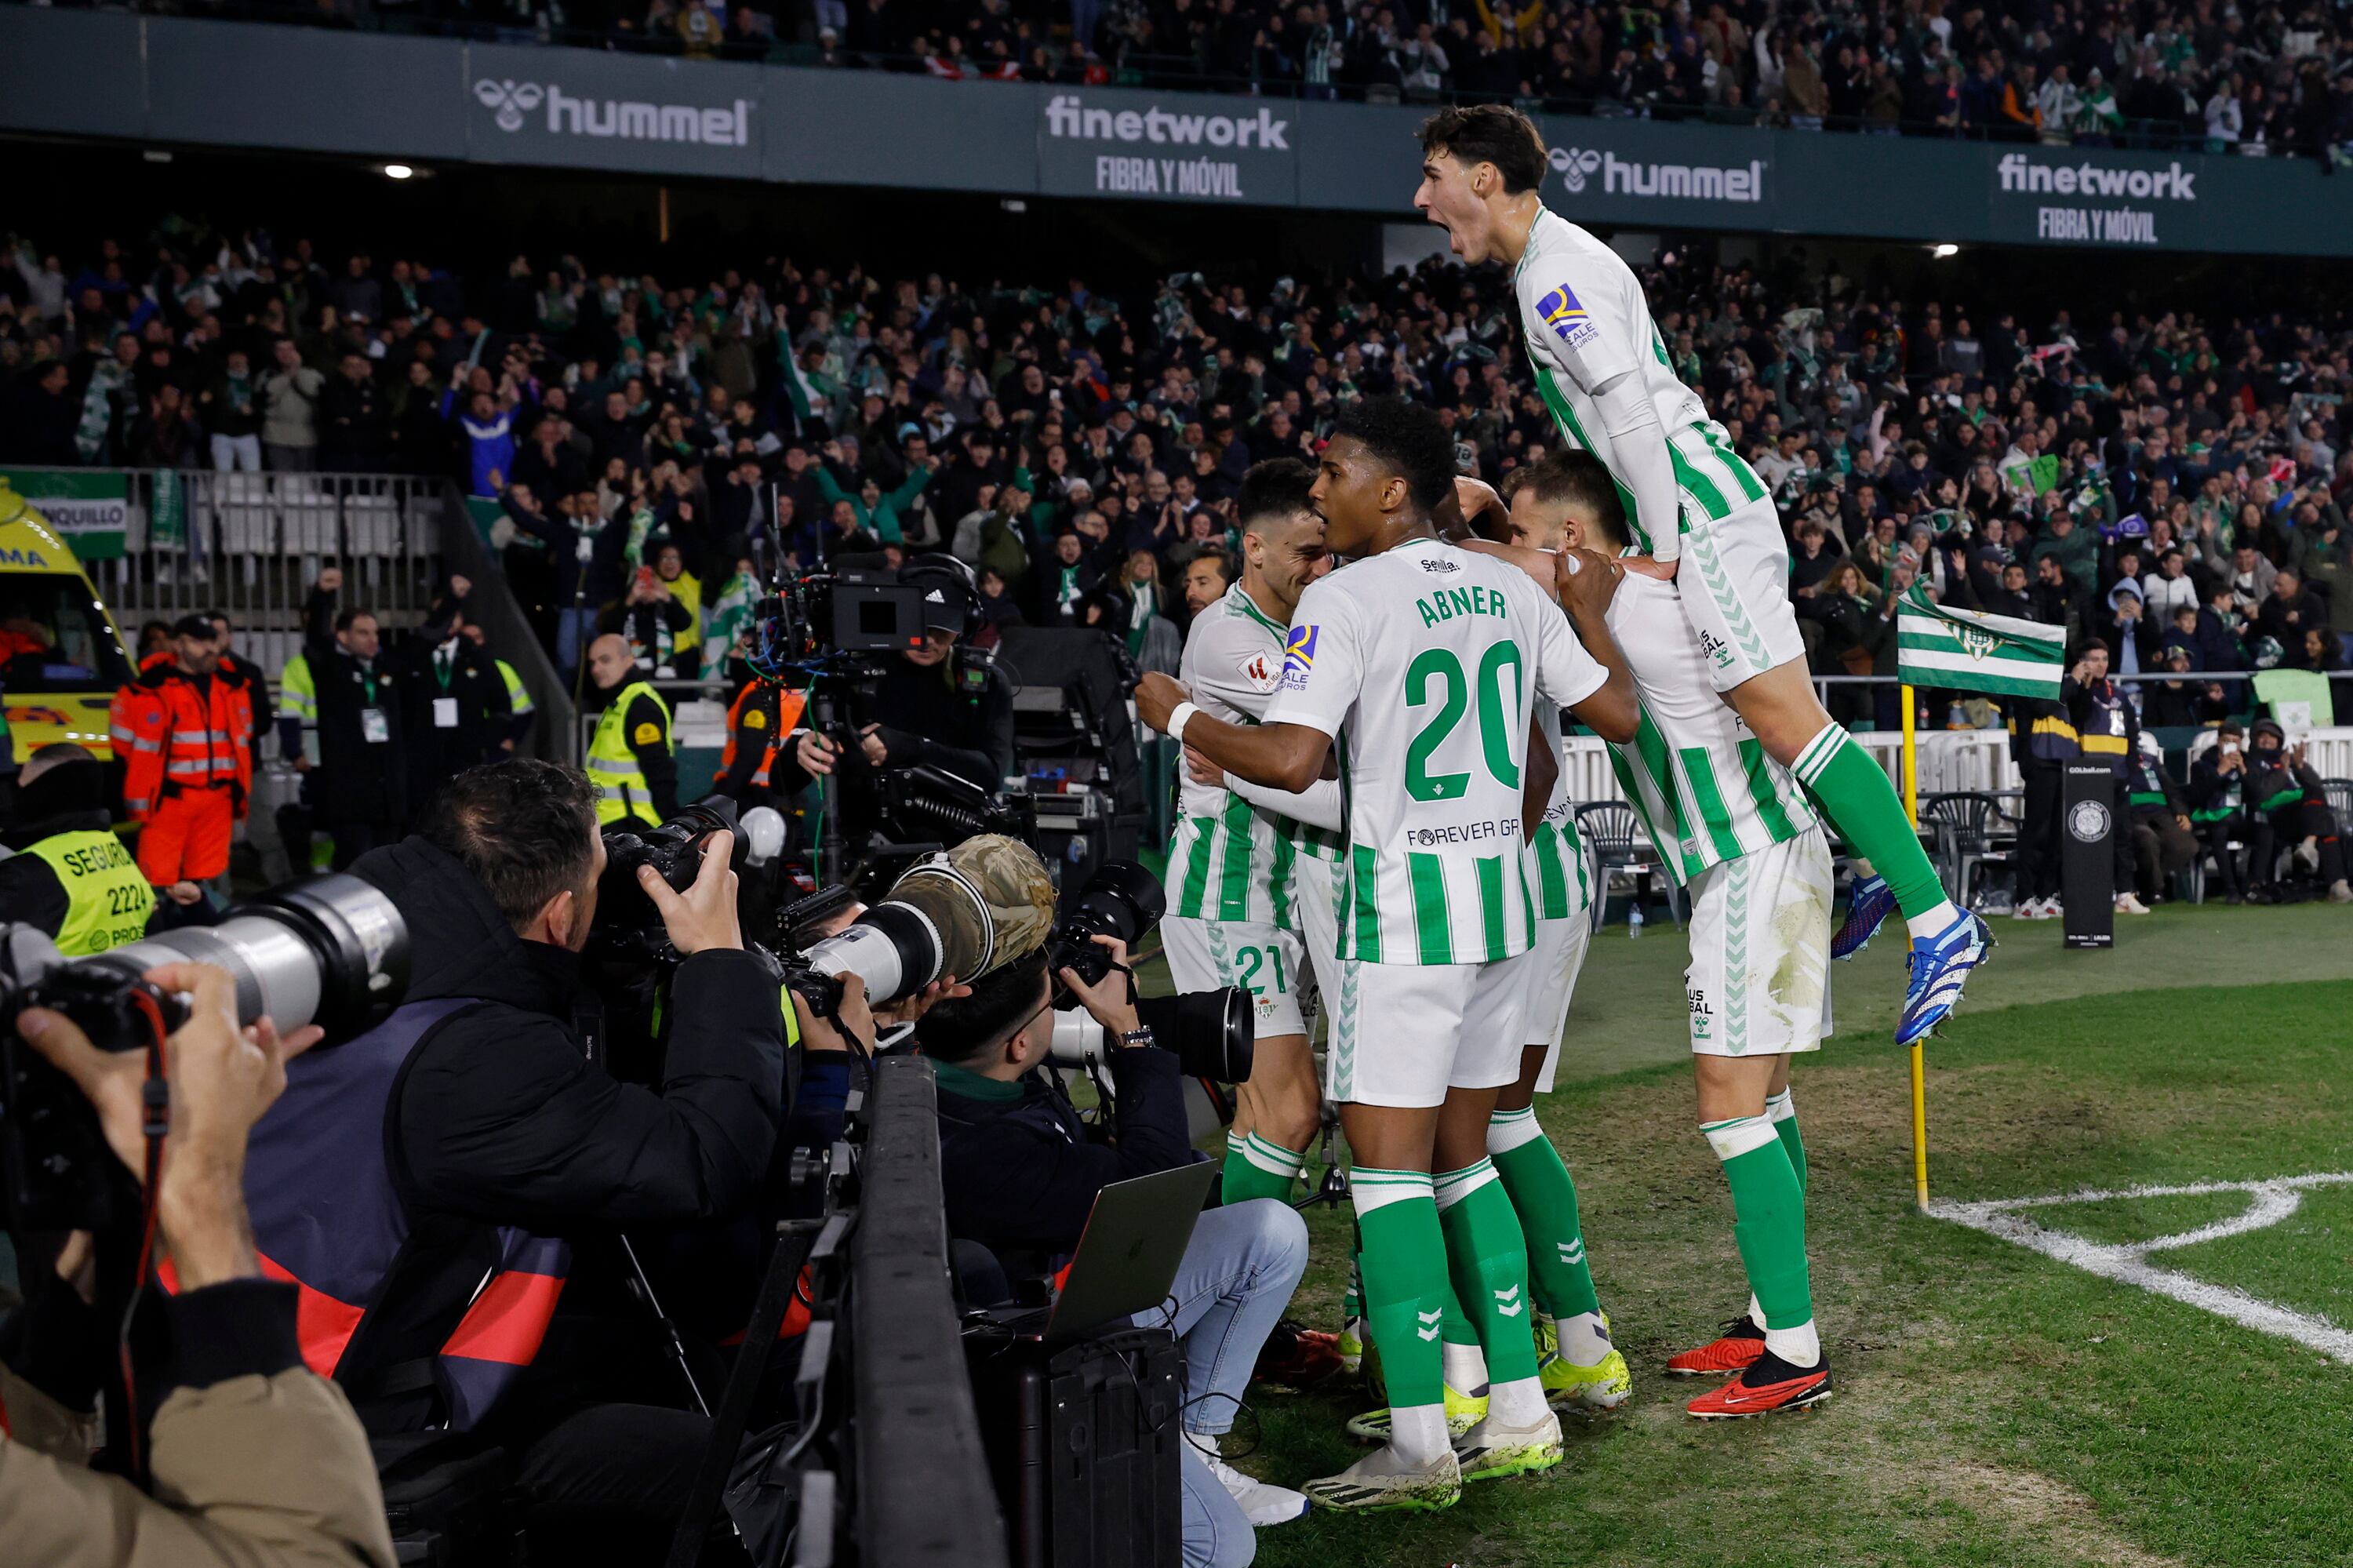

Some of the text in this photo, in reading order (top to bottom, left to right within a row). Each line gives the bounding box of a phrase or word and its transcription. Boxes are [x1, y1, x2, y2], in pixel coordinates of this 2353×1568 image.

[548, 85, 747, 147] hummel
[1046, 96, 1289, 149] finetwork
[1097, 156, 1242, 196] FIBRA Y MÓVIL
[1604, 151, 1762, 201] hummel
[1998, 153, 2195, 199] finetwork
[2039, 205, 2158, 243] FIBRA Y MÓVIL
[36, 506, 123, 527] NQUILLO
[1416, 586, 1506, 628] ABNER
[1405, 639, 1522, 802] 20
[1407, 821, 1496, 846] FOREVER
[107, 885, 147, 915] 2224
[1235, 945, 1286, 995] 21
